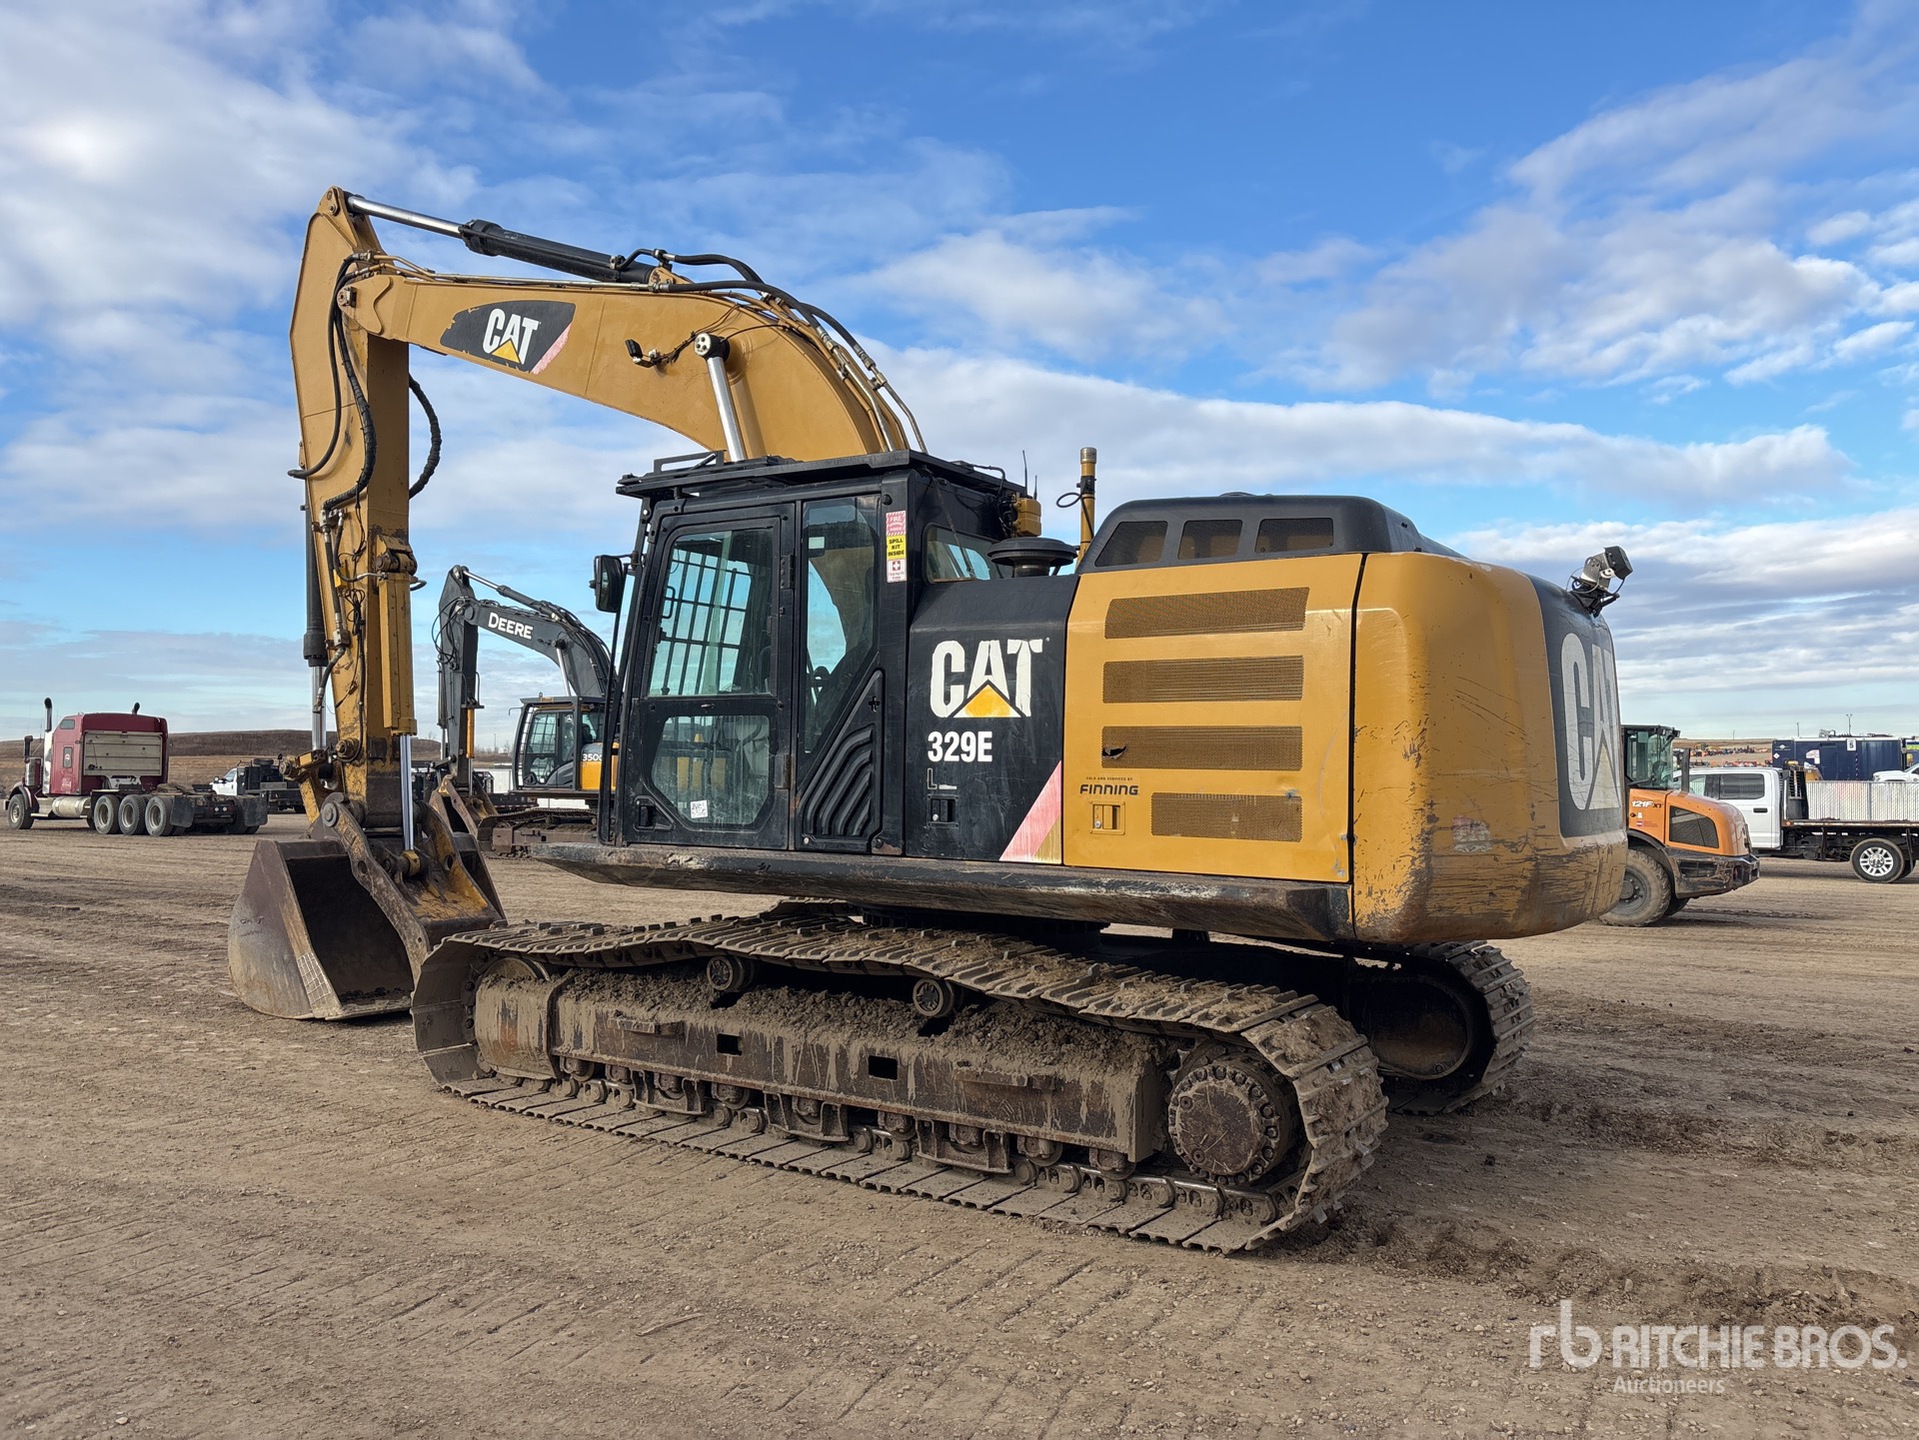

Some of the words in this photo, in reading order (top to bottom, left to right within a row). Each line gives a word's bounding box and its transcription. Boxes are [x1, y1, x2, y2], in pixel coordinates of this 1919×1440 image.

[482, 308, 540, 365] CAT
[488, 612, 534, 640] DEERE
[930, 638, 1043, 718] CAT
[927, 731, 993, 762] 329E
[1080, 784, 1139, 796] FINNING
